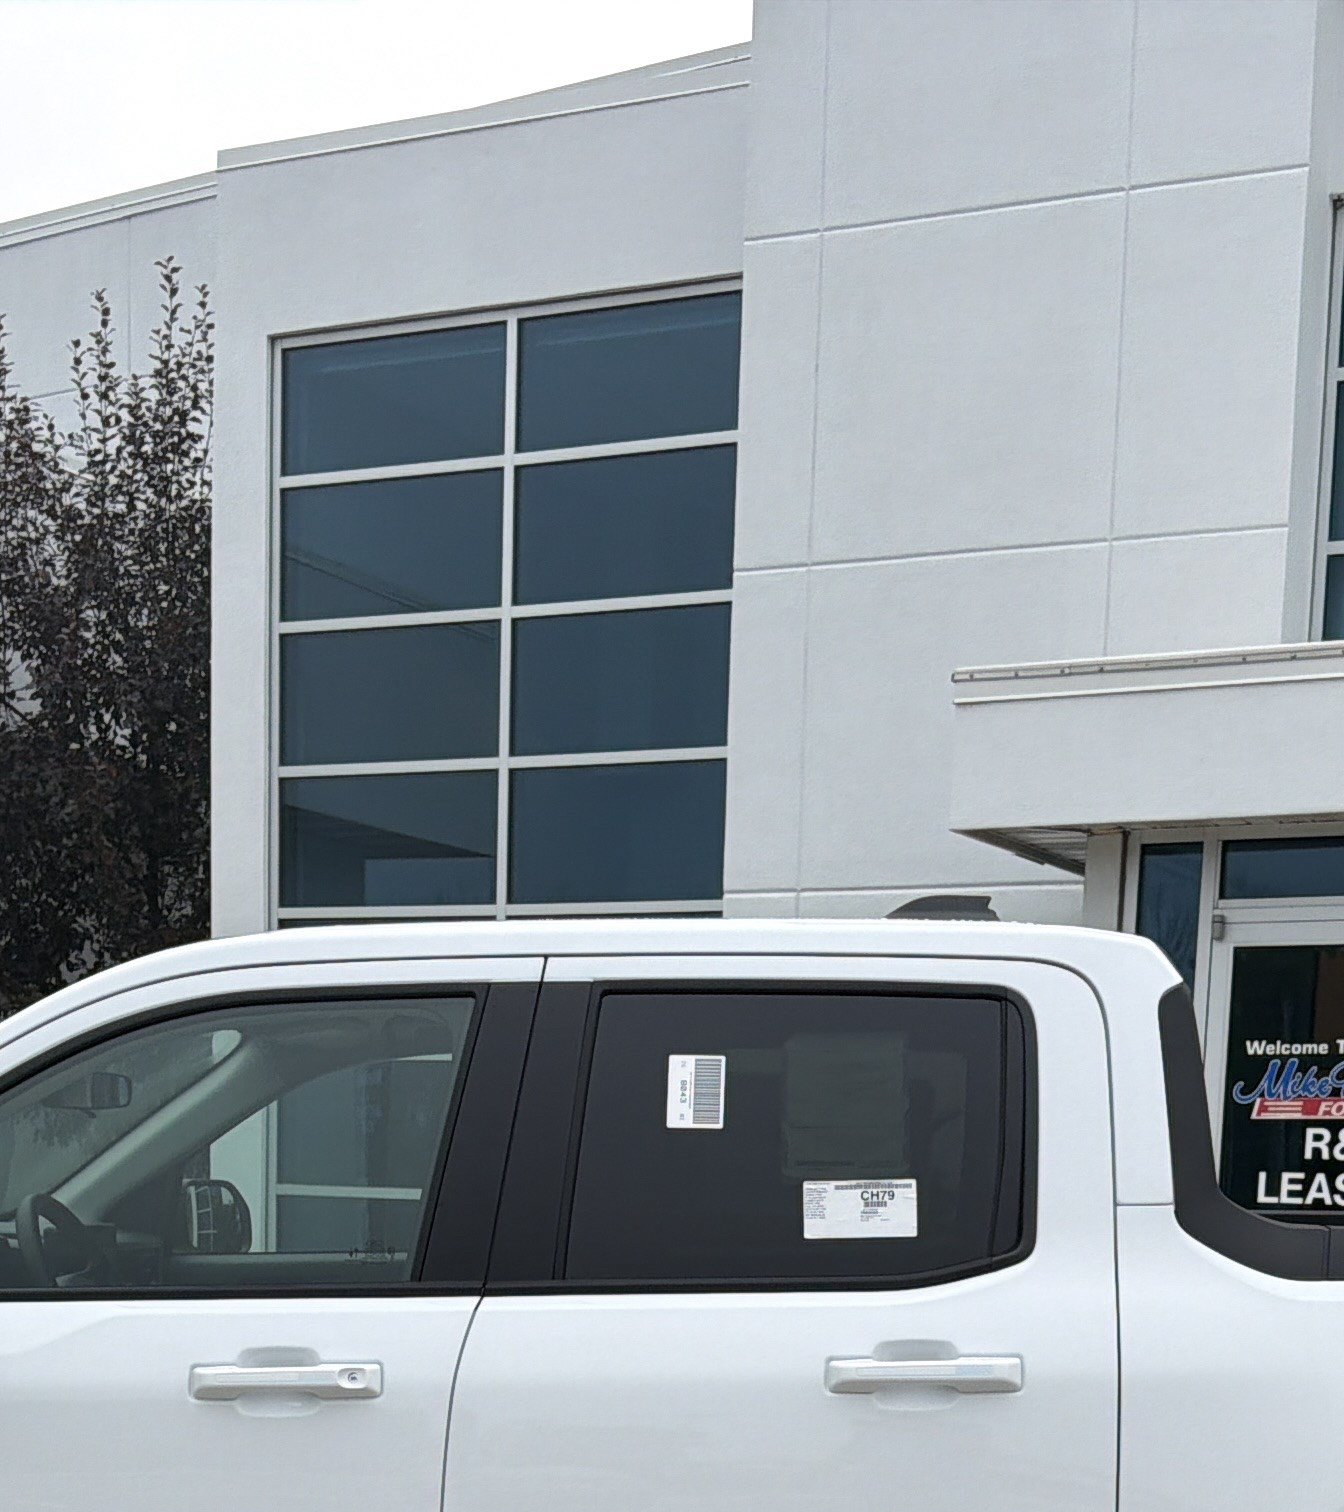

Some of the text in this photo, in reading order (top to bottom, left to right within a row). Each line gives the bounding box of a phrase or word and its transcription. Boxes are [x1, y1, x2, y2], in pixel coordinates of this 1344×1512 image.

[1245, 1039, 1329, 1056] Welcome
[1232, 1057, 1333, 1105] Mike
[860, 1190, 895, 1201] CH79
